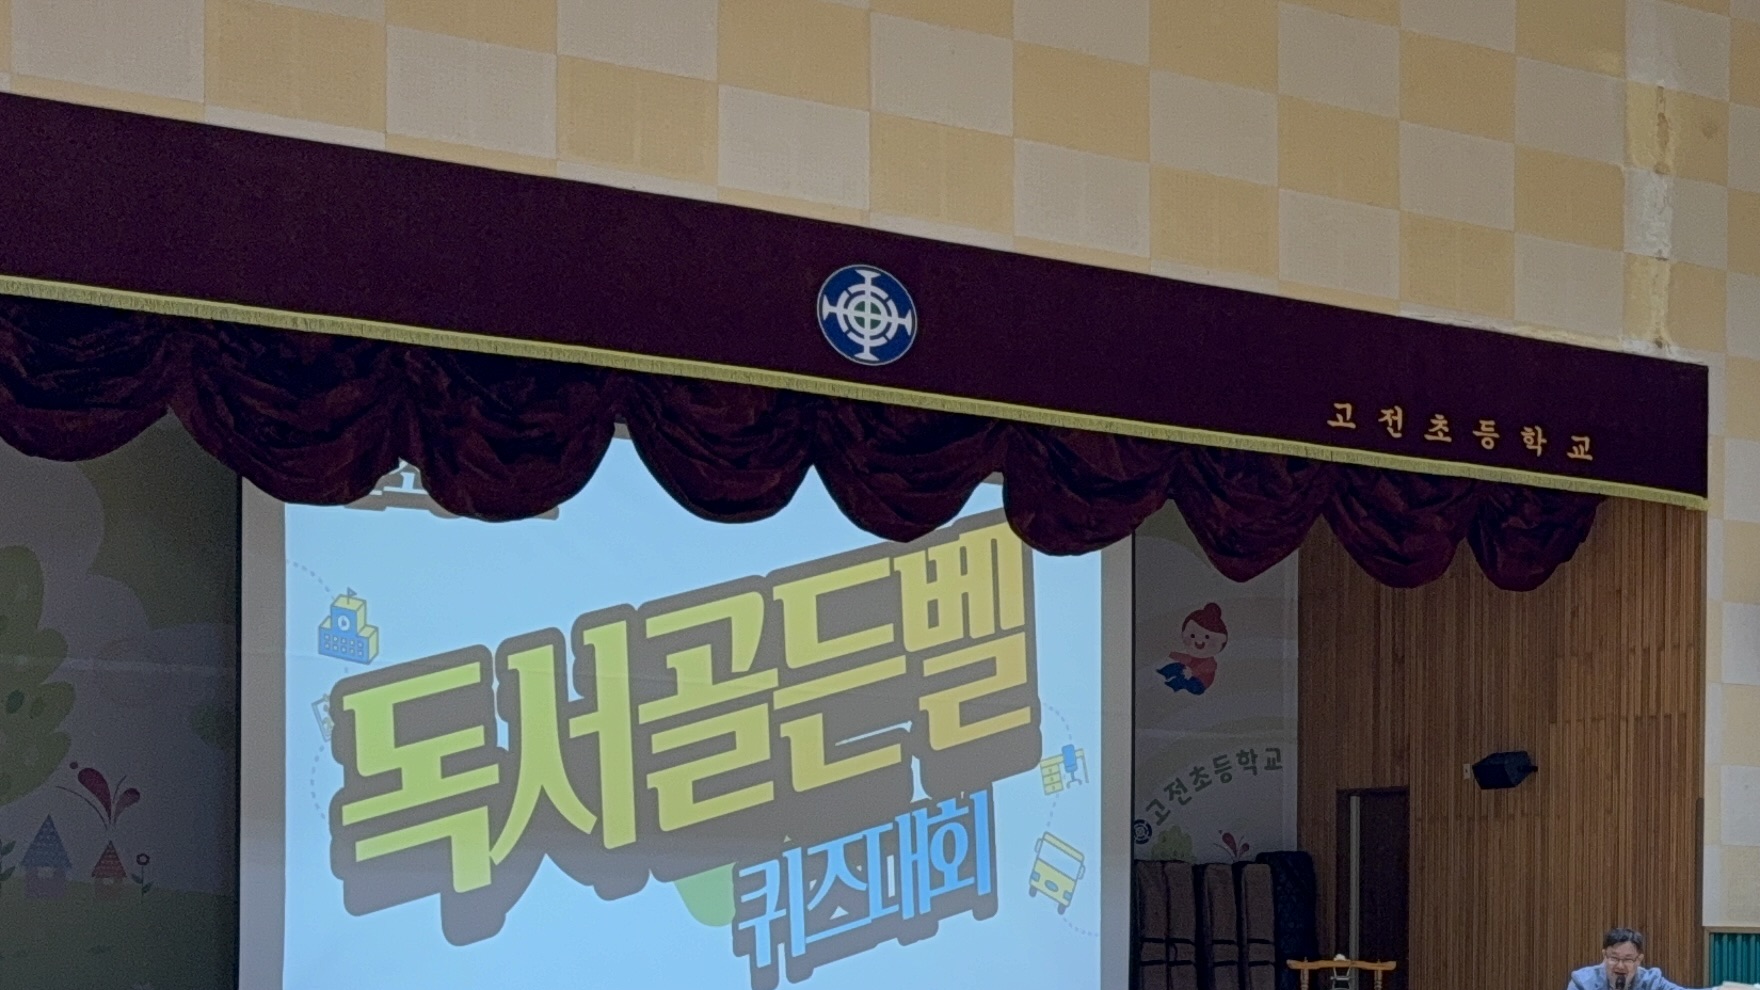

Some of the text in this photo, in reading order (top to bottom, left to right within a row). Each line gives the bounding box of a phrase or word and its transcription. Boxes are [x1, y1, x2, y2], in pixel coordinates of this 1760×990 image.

[1326, 402, 1594, 461] 고전초등학교
[342, 519, 1033, 894] 독서골든벨
[1145, 747, 1283, 826] 고전초등학교
[735, 788, 995, 969] 퀴즈대회
